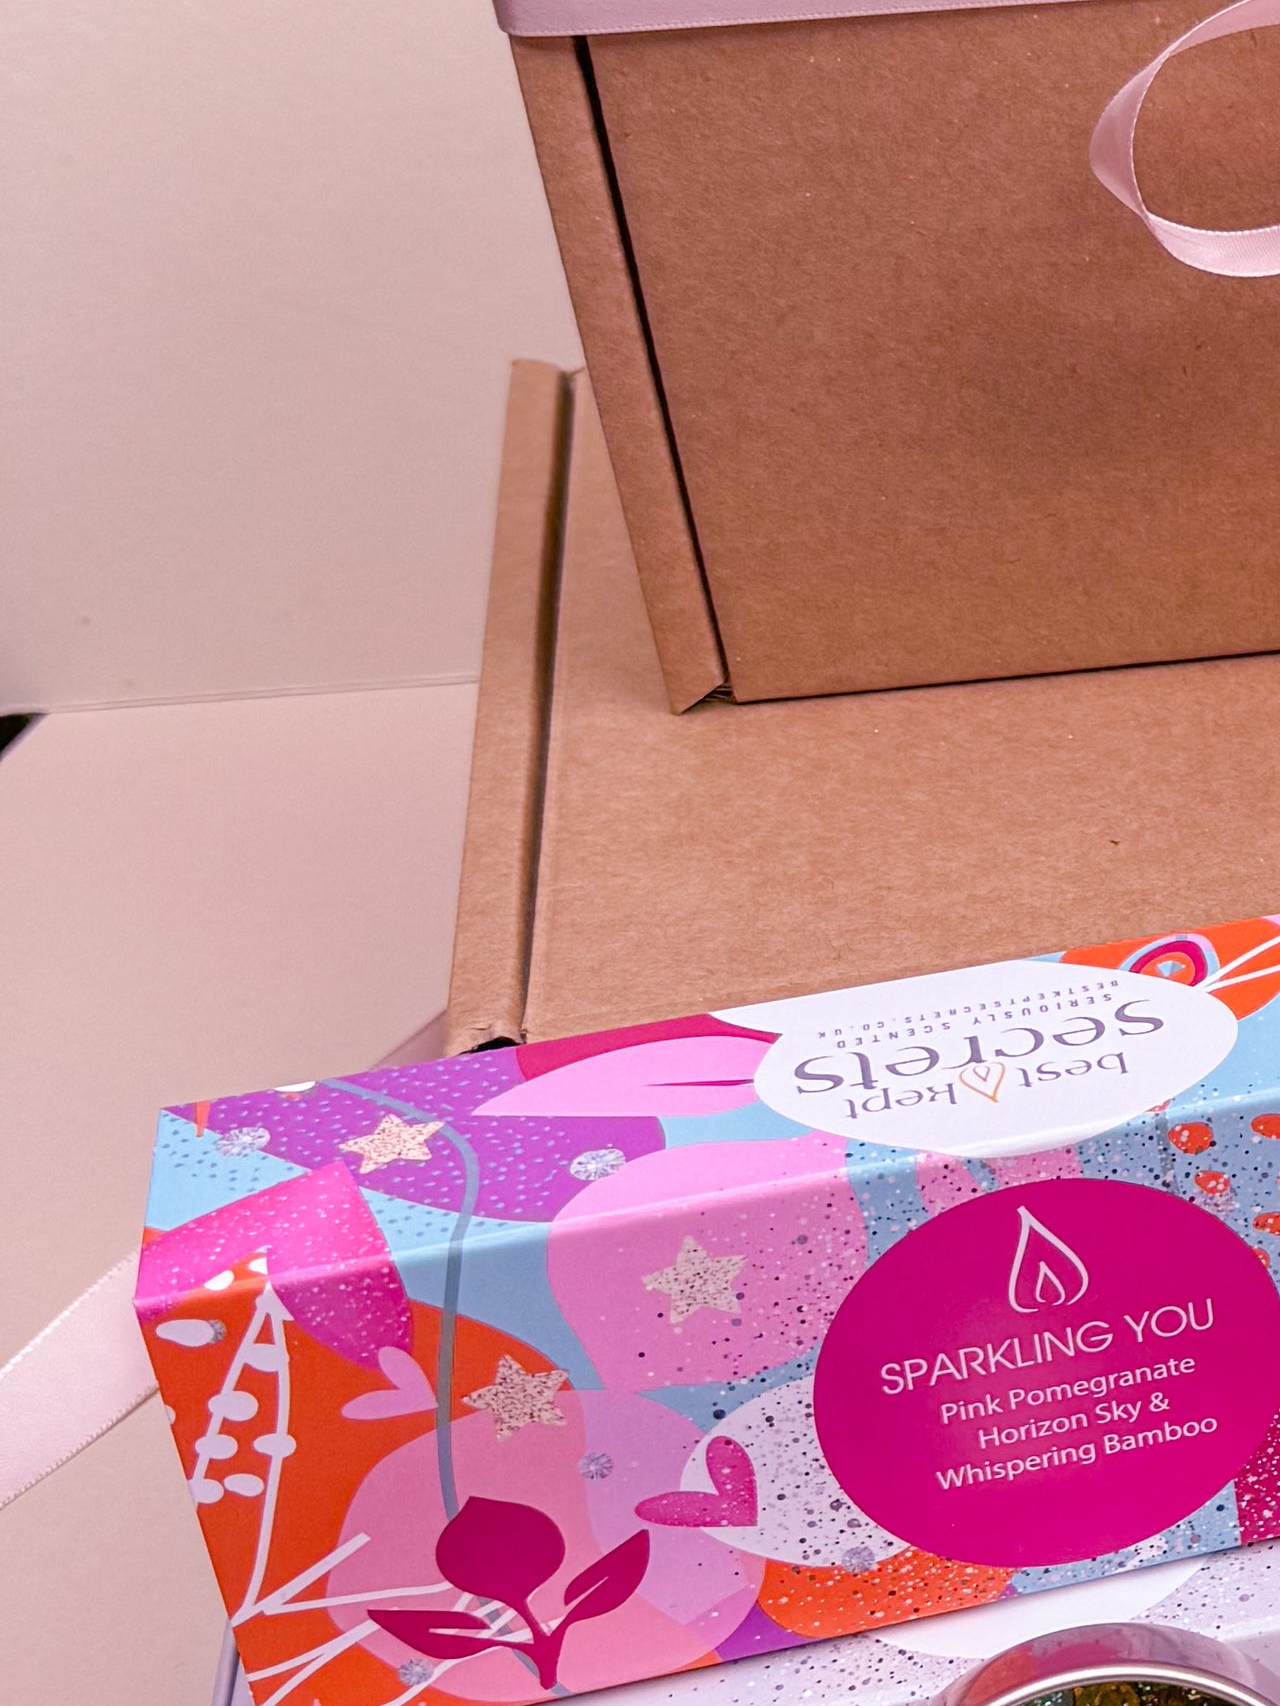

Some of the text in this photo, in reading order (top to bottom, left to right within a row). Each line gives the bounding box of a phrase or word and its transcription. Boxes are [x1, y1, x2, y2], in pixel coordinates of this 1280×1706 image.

[794, 999, 1165, 1095] secrets
[837, 993, 1113, 1049] SERIOUSLY SCENTED
[842, 1052, 1129, 1119] best kept
[880, 1297, 1215, 1396] SPARKLING YOU
[940, 1357, 1196, 1425] Pink Pomegranate
[978, 1391, 1170, 1450] Horizon Sky &
[936, 1417, 1218, 1490] Whispering Bamboo
